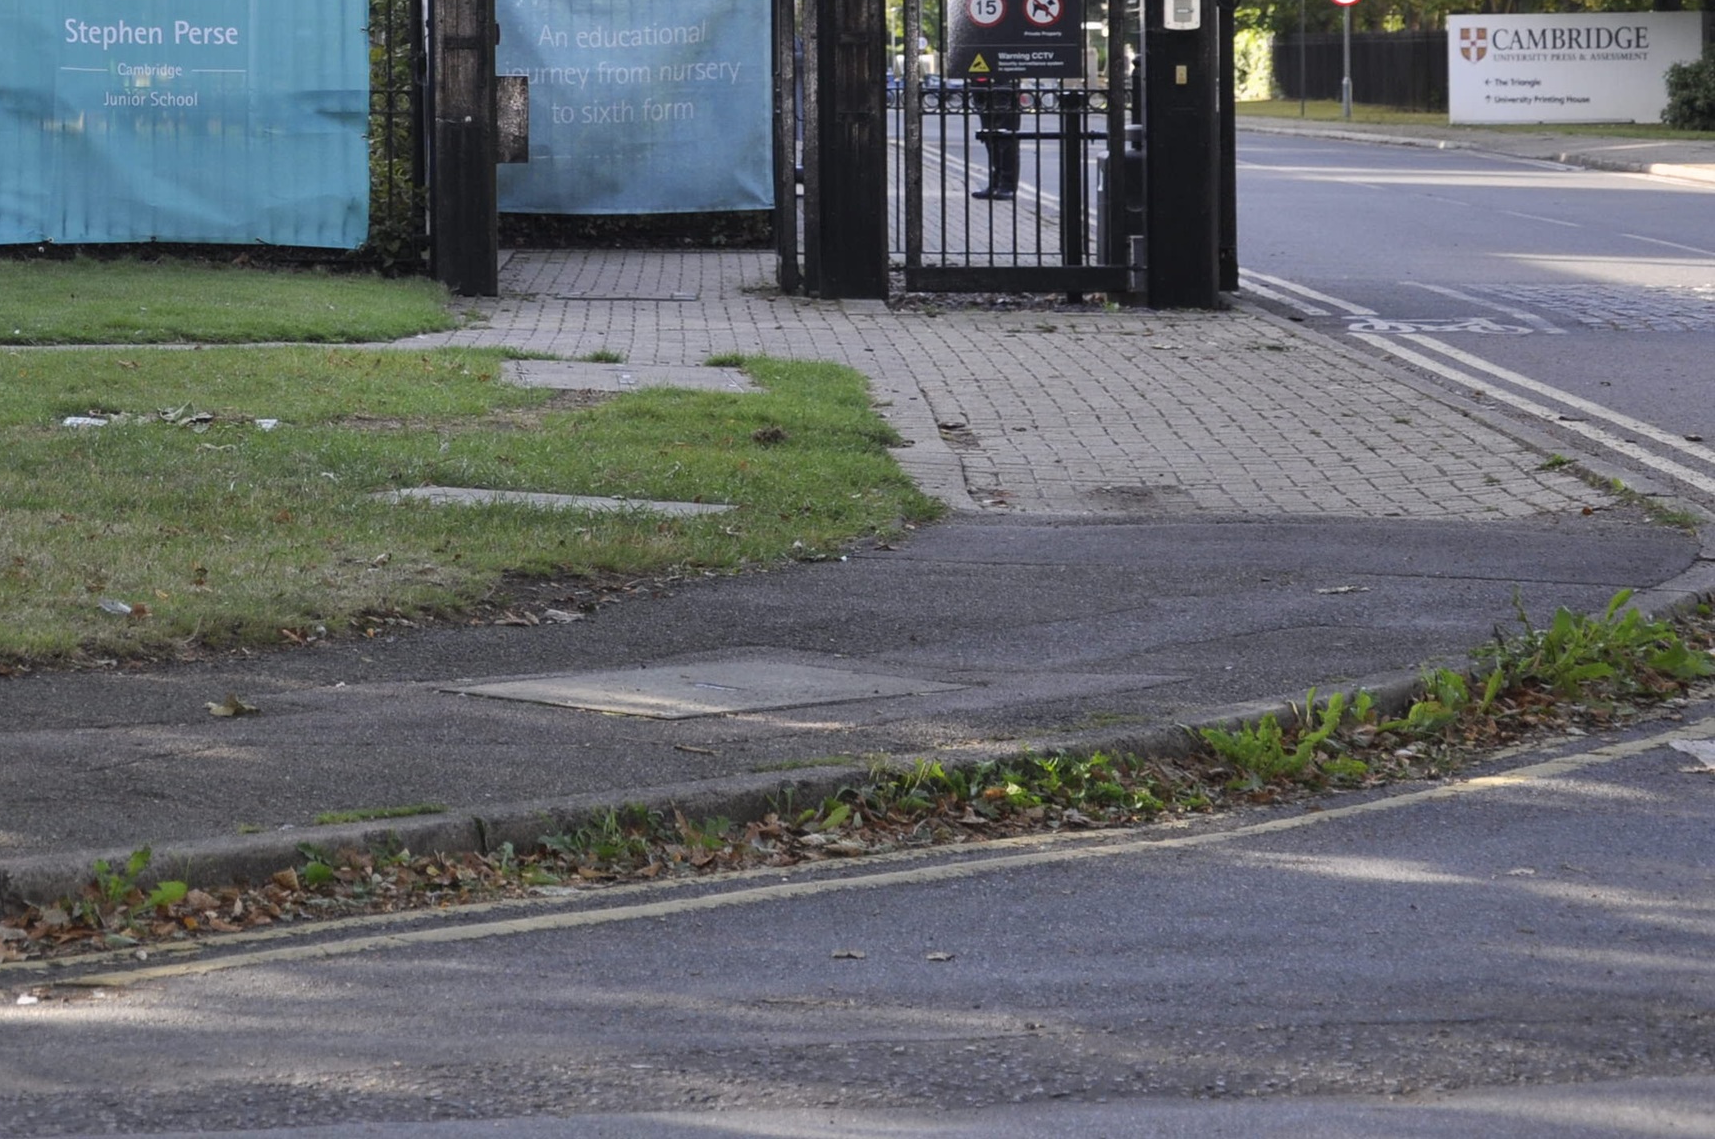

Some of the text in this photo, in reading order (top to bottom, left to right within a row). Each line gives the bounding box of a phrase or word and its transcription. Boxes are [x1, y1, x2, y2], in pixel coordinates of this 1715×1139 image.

[976, 0, 997, 15] 15
[65, 18, 238, 51] Stephen Perse
[538, 19, 707, 49] An educational
[1492, 26, 1650, 51] CAMBRIDGE
[998, 52, 1054, 61] Warning CCTV
[1493, 53, 1548, 62] UNIVERSITY
[1551, 53, 1577, 61] PRESS
[1590, 52, 1649, 61] ASSESSMENT
[117, 63, 183, 79] Cambridge
[597, 61, 651, 85] from
[659, 61, 741, 85] nursery
[1495, 78, 1541, 88] The Triangle
[103, 91, 198, 107] Junior School
[1494, 95, 1590, 106] University Printing House
[551, 97, 695, 125] to sixth form
